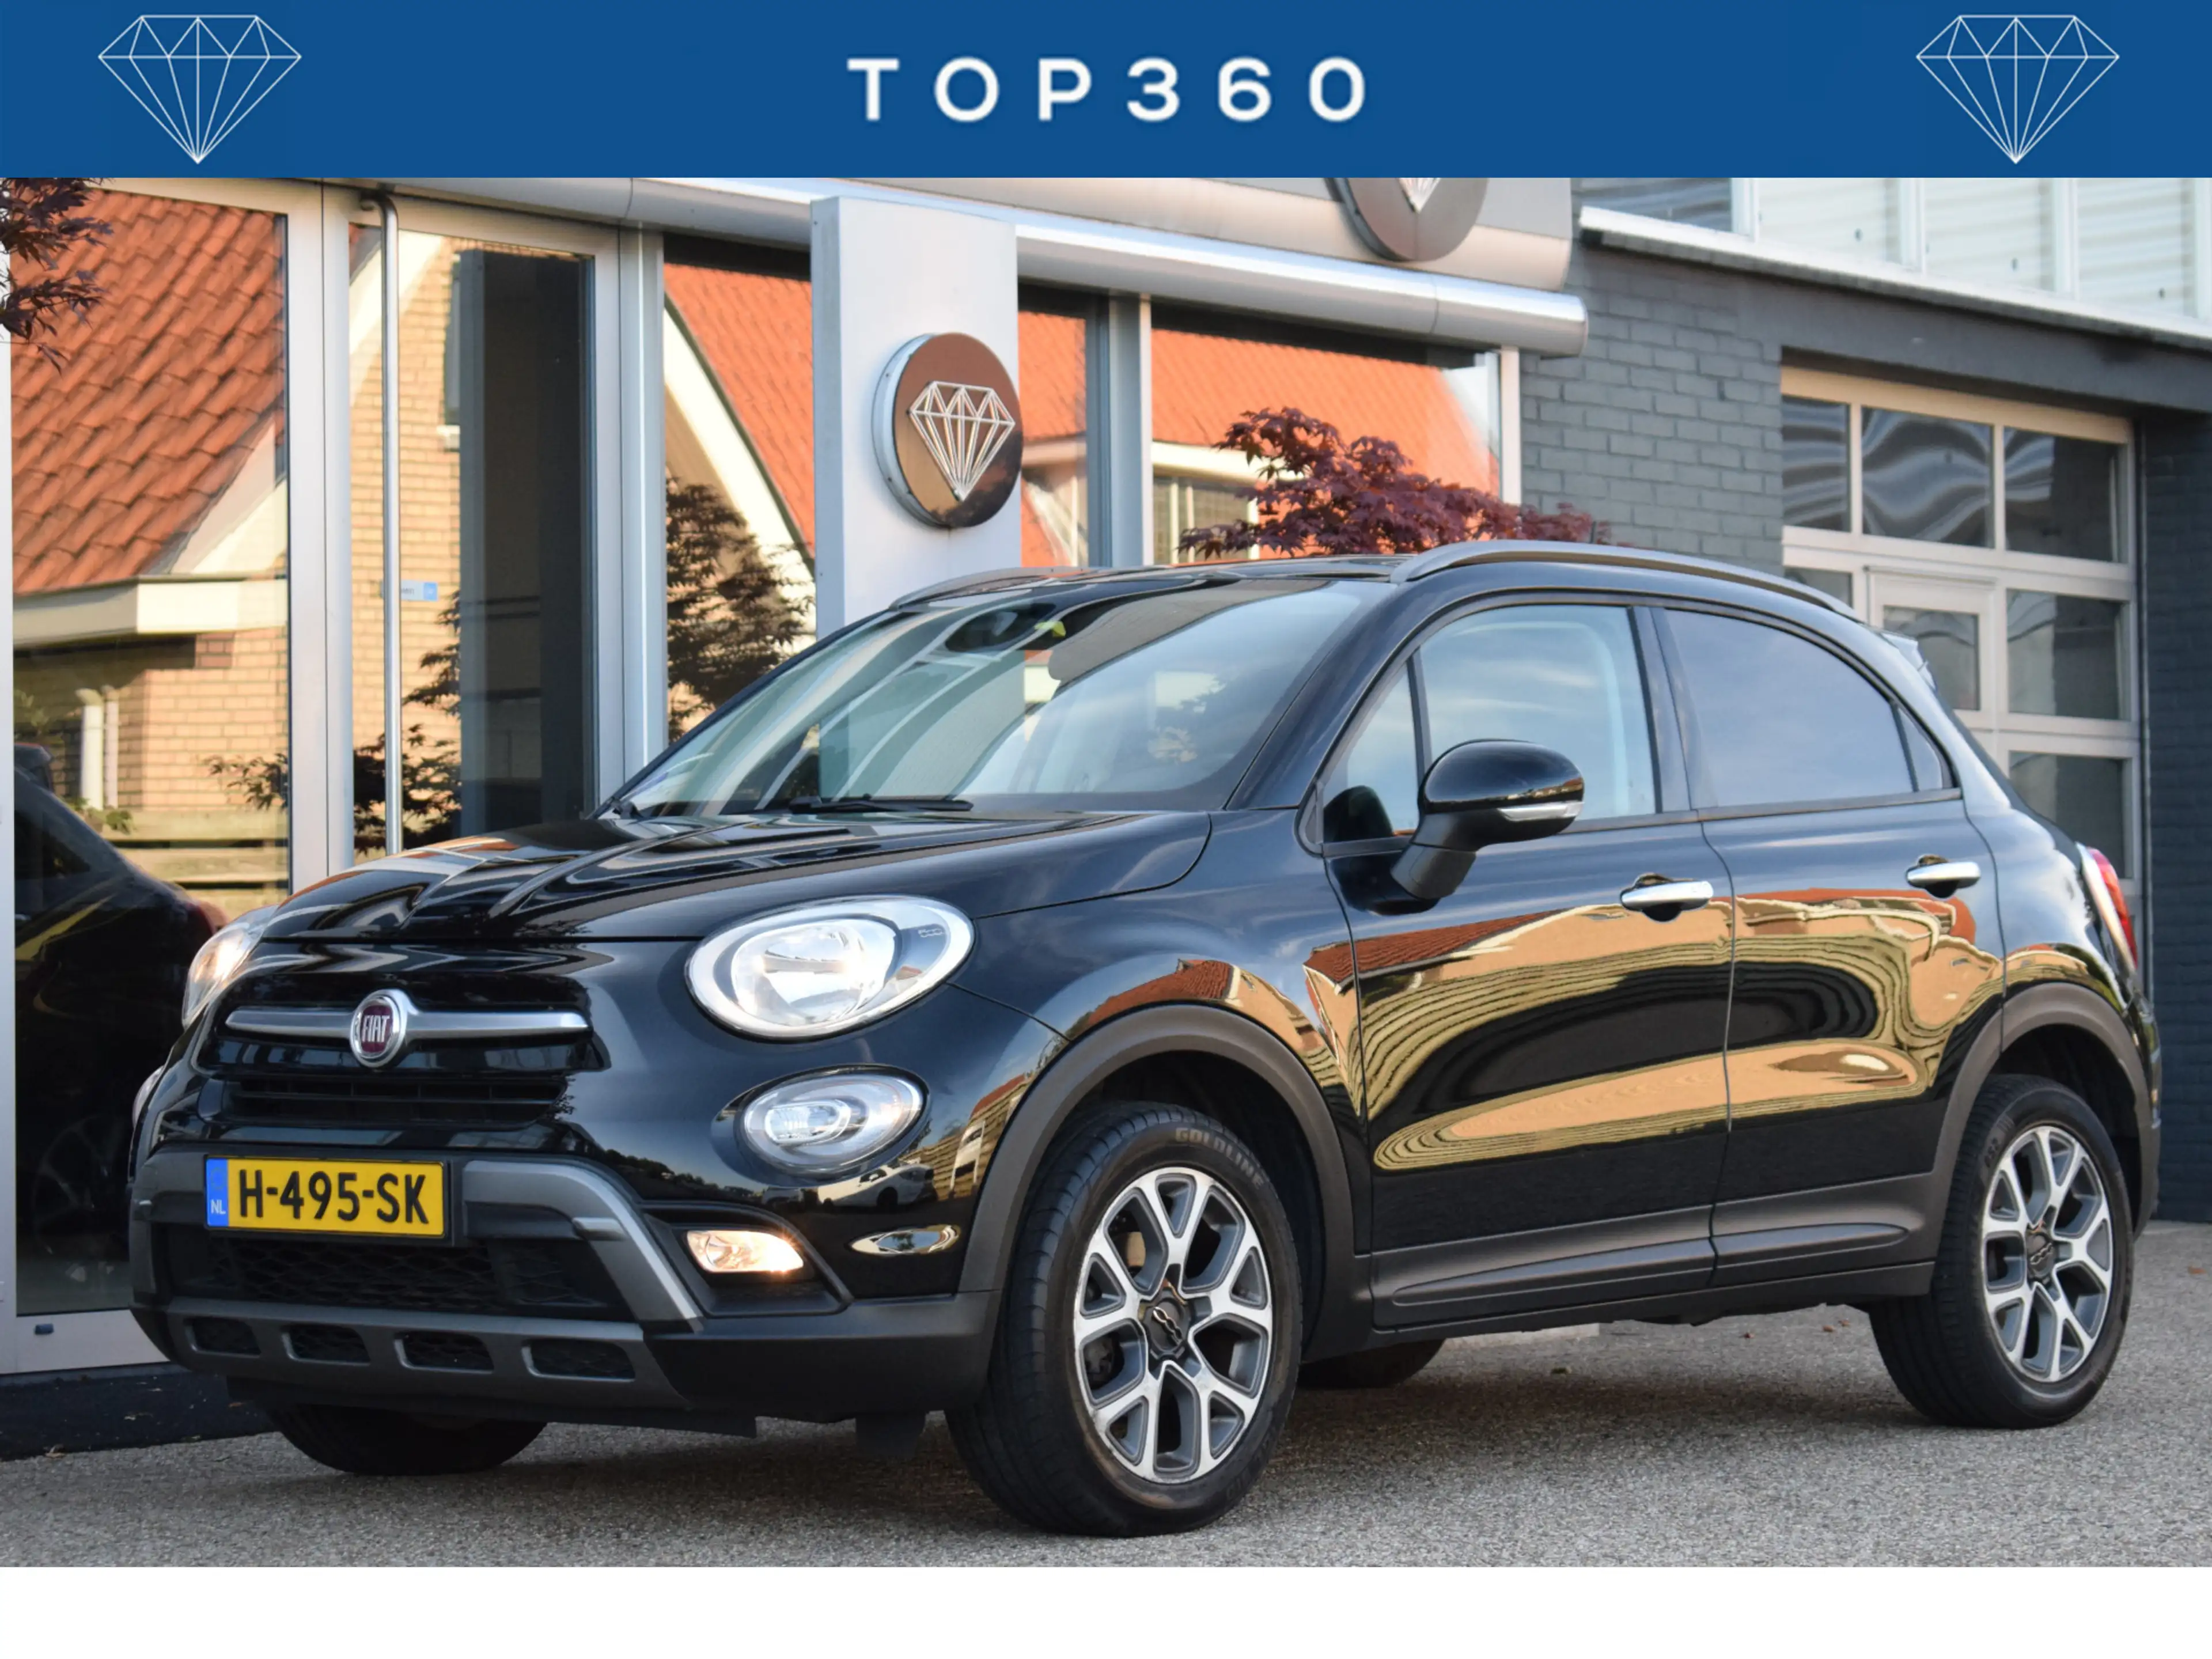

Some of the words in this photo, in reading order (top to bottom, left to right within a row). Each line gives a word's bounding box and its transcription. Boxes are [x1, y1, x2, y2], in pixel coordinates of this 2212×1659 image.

[361, 1014, 391, 1043] FIAT
[210, 1199, 226, 1215] NL
[238, 1169, 429, 1225] H-495-SK
